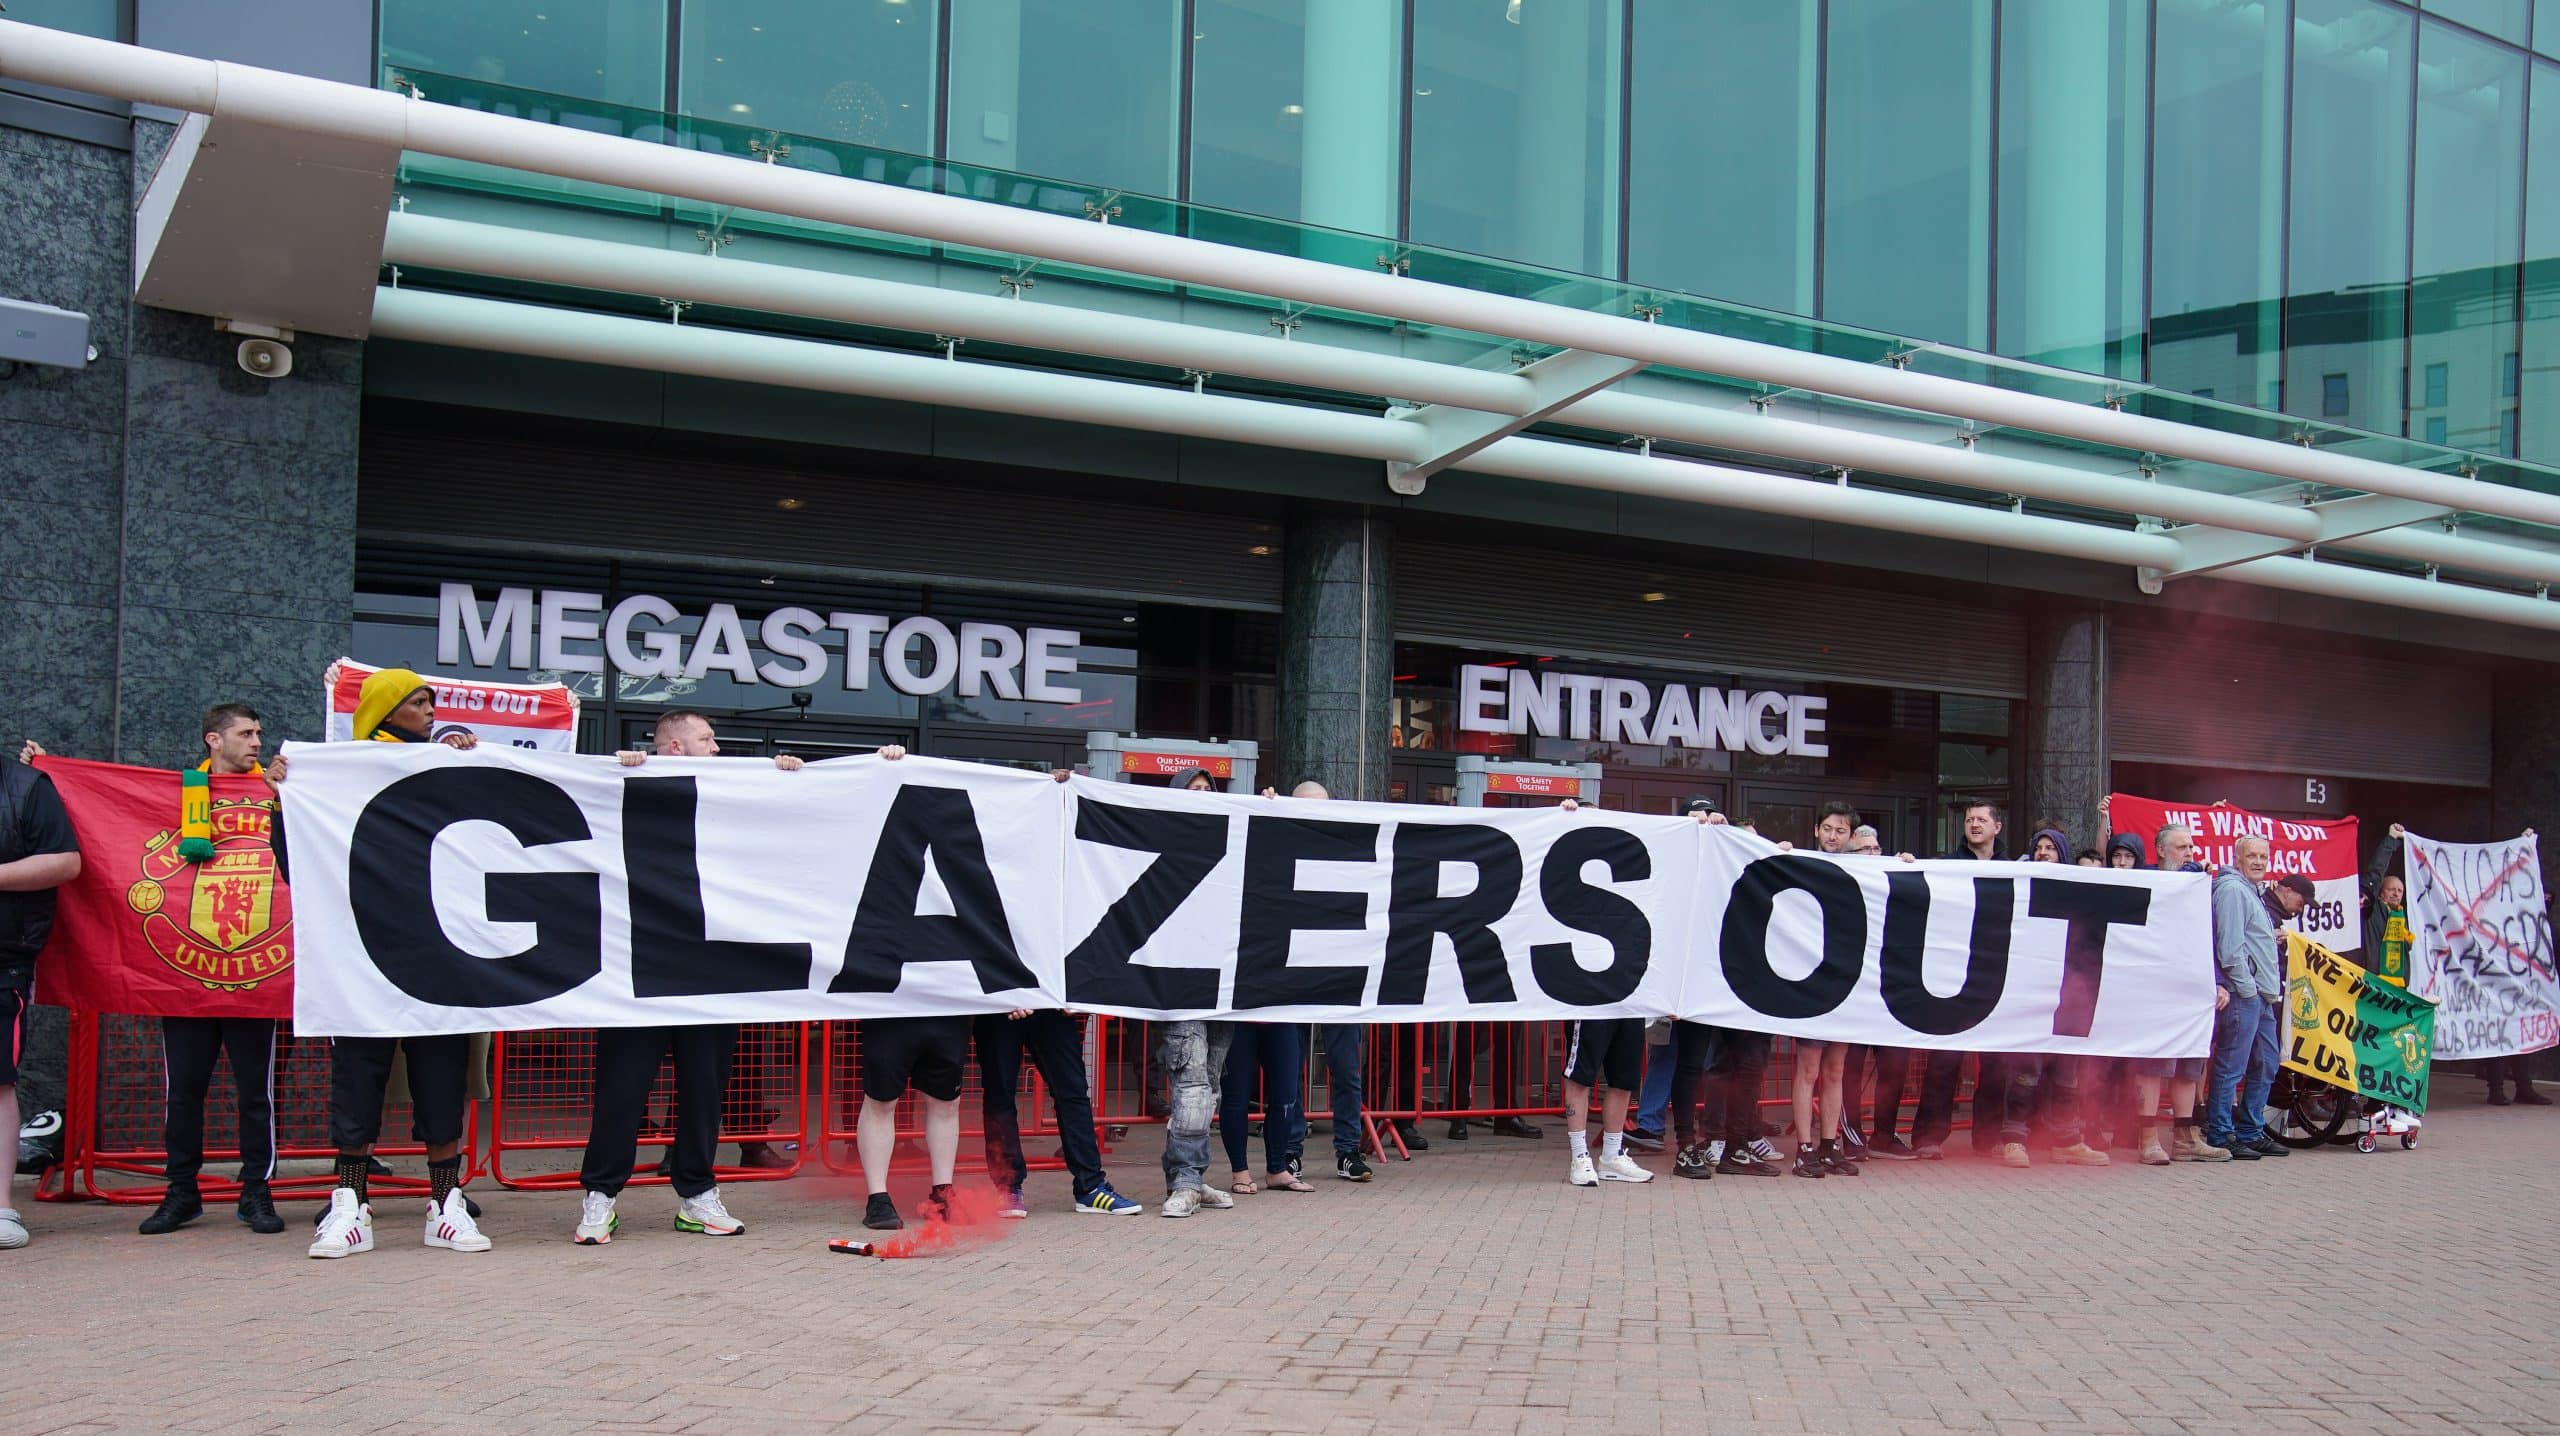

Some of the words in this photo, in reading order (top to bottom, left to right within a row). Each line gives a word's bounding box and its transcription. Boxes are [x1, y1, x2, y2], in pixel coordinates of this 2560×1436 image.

[437, 582, 1082, 704] MEGASTORE
[491, 691, 542, 715] OUT
[1460, 664, 1829, 757] ENTRANCE
[2306, 778, 2326, 804] E3
[2208, 811, 2274, 841] WANT
[2192, 845, 2235, 871] CLU
[2266, 850, 2317, 874] ACK
[349, 766, 1652, 1010] GLAZERS
[1719, 855, 2151, 1037] OUT
[2298, 900, 2345, 932] 1958
[175, 943, 287, 977] UNITED
[2304, 943, 2342, 985] WE
[2328, 1007, 2380, 1050] OUR
[2433, 1019, 2464, 1053] LUB
[2465, 1016, 2514, 1051] BACK
[2291, 1036, 2350, 1081] LUB
[2359, 1063, 2424, 1109] BACK
